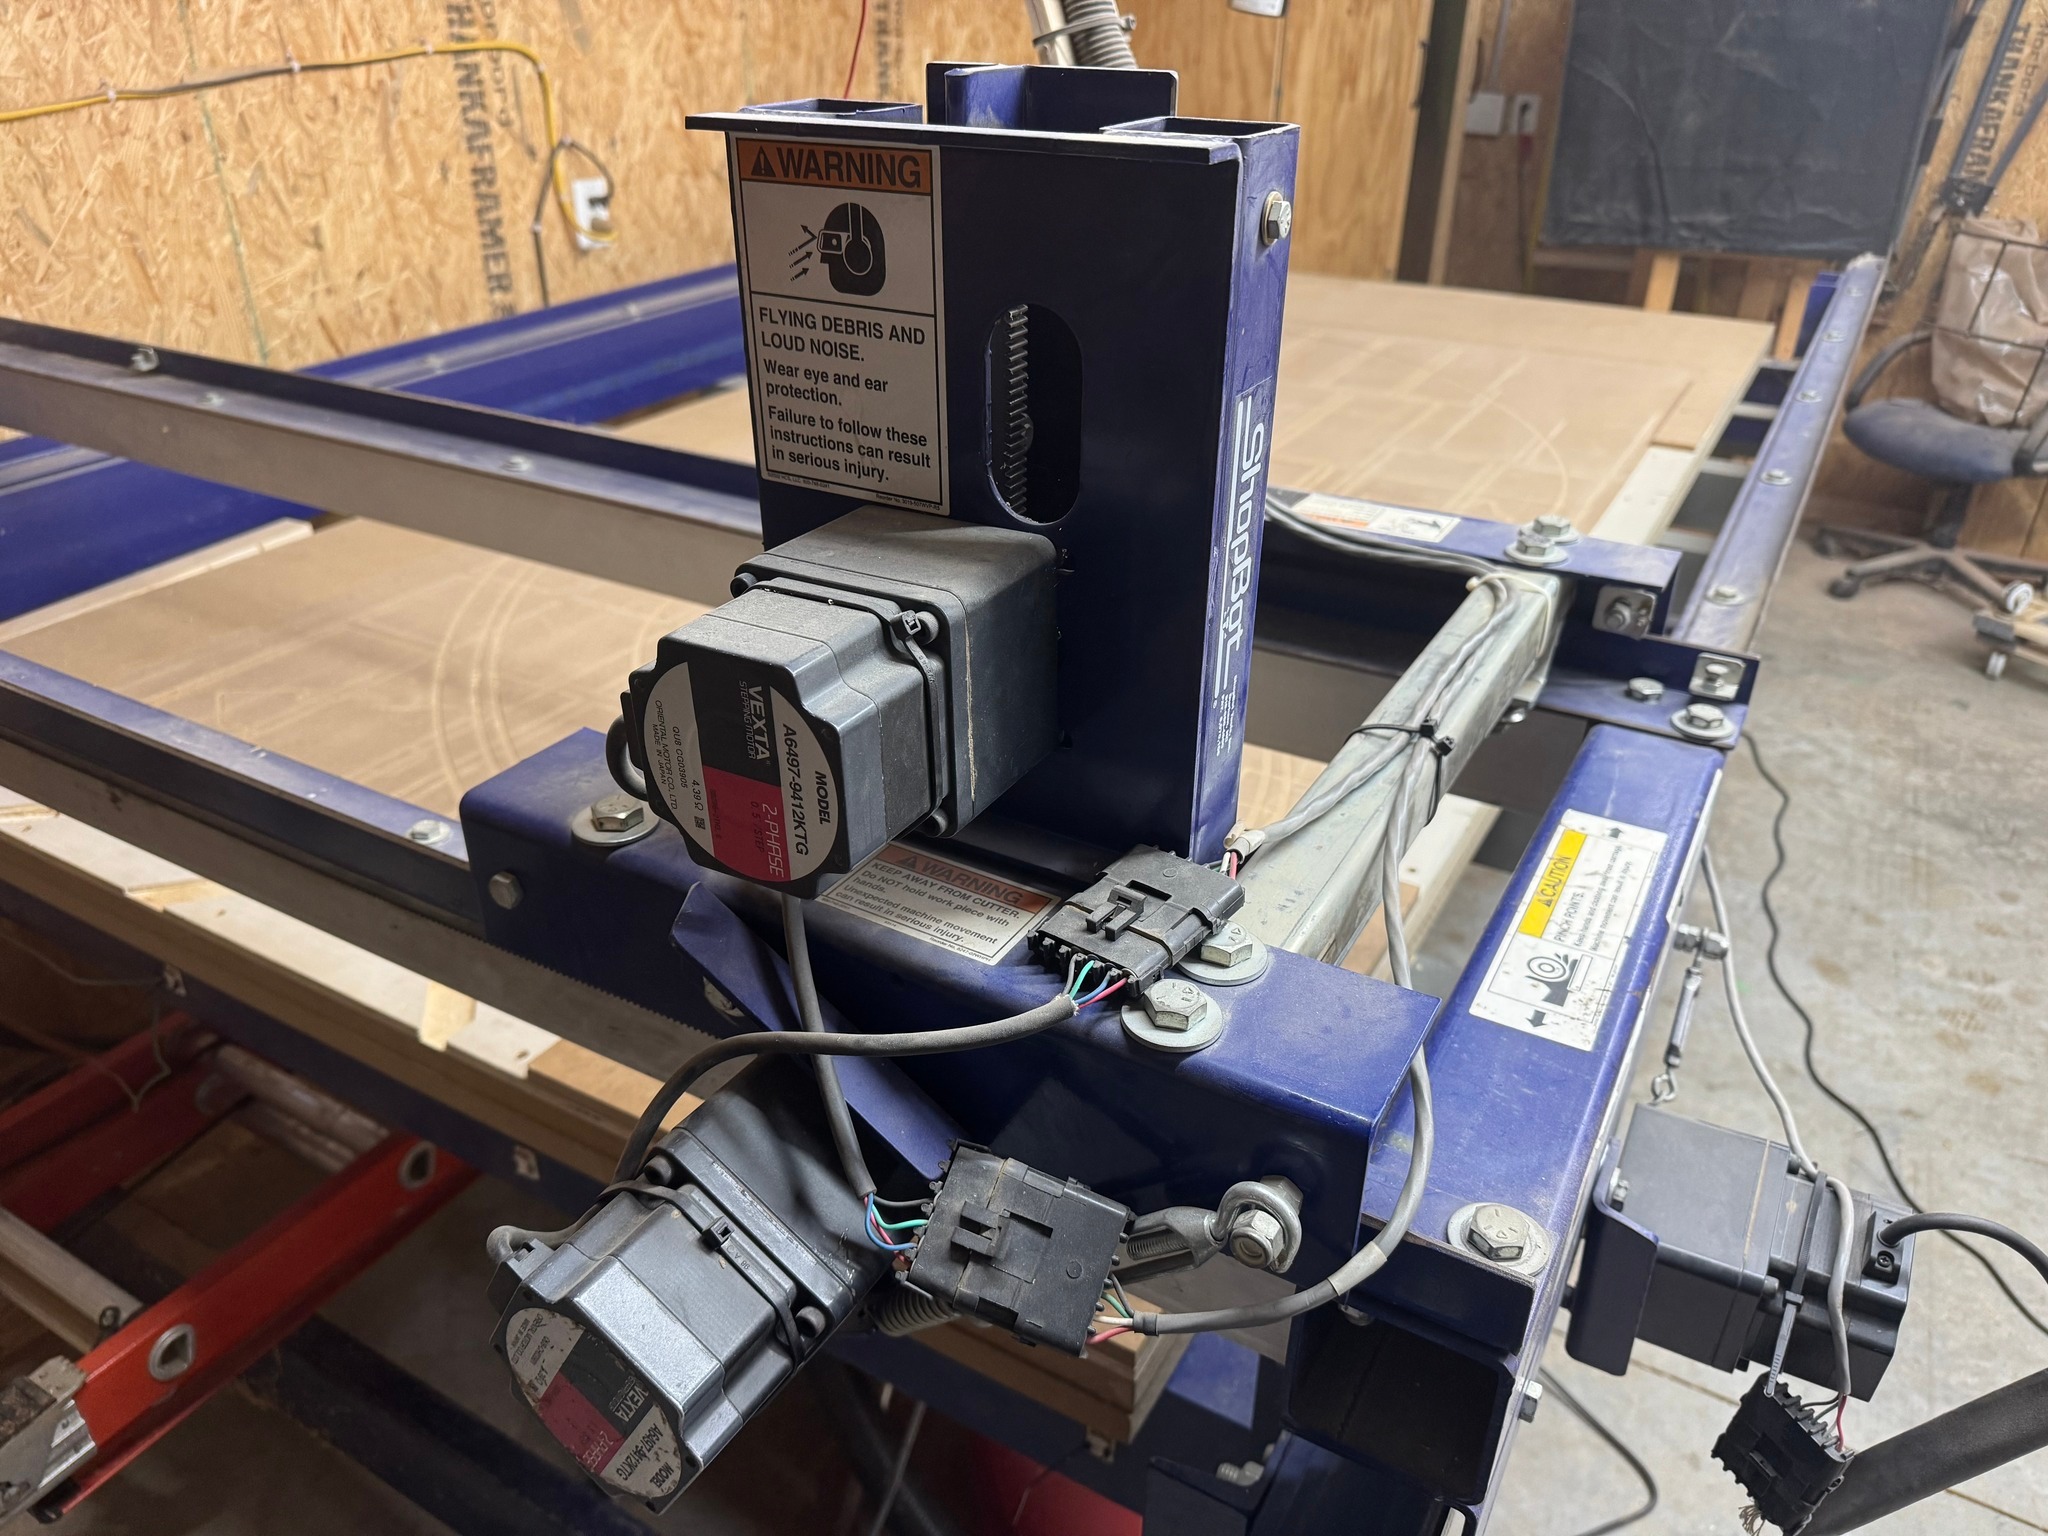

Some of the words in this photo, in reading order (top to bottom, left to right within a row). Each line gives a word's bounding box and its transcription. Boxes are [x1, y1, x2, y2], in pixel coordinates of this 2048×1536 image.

[776, 147, 921, 188] WARNING
[759, 307, 816, 330] FLYING
[821, 315, 884, 339] DEBRIS
[888, 325, 925, 345] AND
[761, 331, 805, 352] LOUD
[810, 339, 865, 362] NOISE.
[764, 358, 799, 378] Wear
[804, 367, 829, 385] eye
[833, 373, 860, 388] and
[864, 378, 888, 392] ear
[766, 382, 842, 406] protection.
[768, 405, 816, 426] Failure
[820, 415, 834, 430] to
[838, 419, 882, 439] follow
[886, 426, 927, 446] these
[770, 426, 853, 454] instructions
[857, 445, 884, 459] can
[888, 449, 931, 468] result
[772, 446, 784, 460] in
[789, 449, 840, 471] serious
[844, 459, 889, 483] injury.
[1223, 394, 1264, 690] ShopBot
[652, 723, 661, 746] MADE
[655, 700, 667, 742] ORIENTAL
[662, 743, 673, 776] MOTOR
[672, 726, 682, 746] QU8
[739, 680, 752, 723] STEPPING
[746, 725, 757, 759] MOTOR
[749, 686, 770, 760] VEXTA
[656, 749, 662, 757] IN
[658, 760, 667, 785] JAPAN
[676, 749, 688, 788] CG03905
[783, 723, 809, 856] A6497-9412KTG
[814, 770, 831, 825] MODEL
[762, 803, 785, 878] 2-PHASE
[853, 877, 887, 894] hands.
[861, 870, 877, 879] Do
[879, 875, 903, 888] NOT
[902, 884, 928, 897] hold
[927, 893, 955, 907] work
[954, 904, 984, 918] piece
[986, 913, 1010, 927] with
[871, 862, 902, 875] KEEP
[902, 873, 937, 888] AWAY
[937, 885, 972, 901] FROM
[972, 897, 1020, 919] CUTTER.
[921, 861, 1024, 905] WARNING
[1539, 856, 1573, 900] CAUTION
[835, 892, 854, 901] can
[854, 898, 884, 911] result
[883, 908, 894, 916] in
[895, 912, 933, 931] serious
[933, 926, 964, 943] injury.
[843, 884, 902, 909] Unexpected
[900, 906, 943, 924] machine
[943, 921, 998, 944] movement
[614, 1385, 649, 1423] VEXTA
[649, 1461, 674, 1488] MODEL
